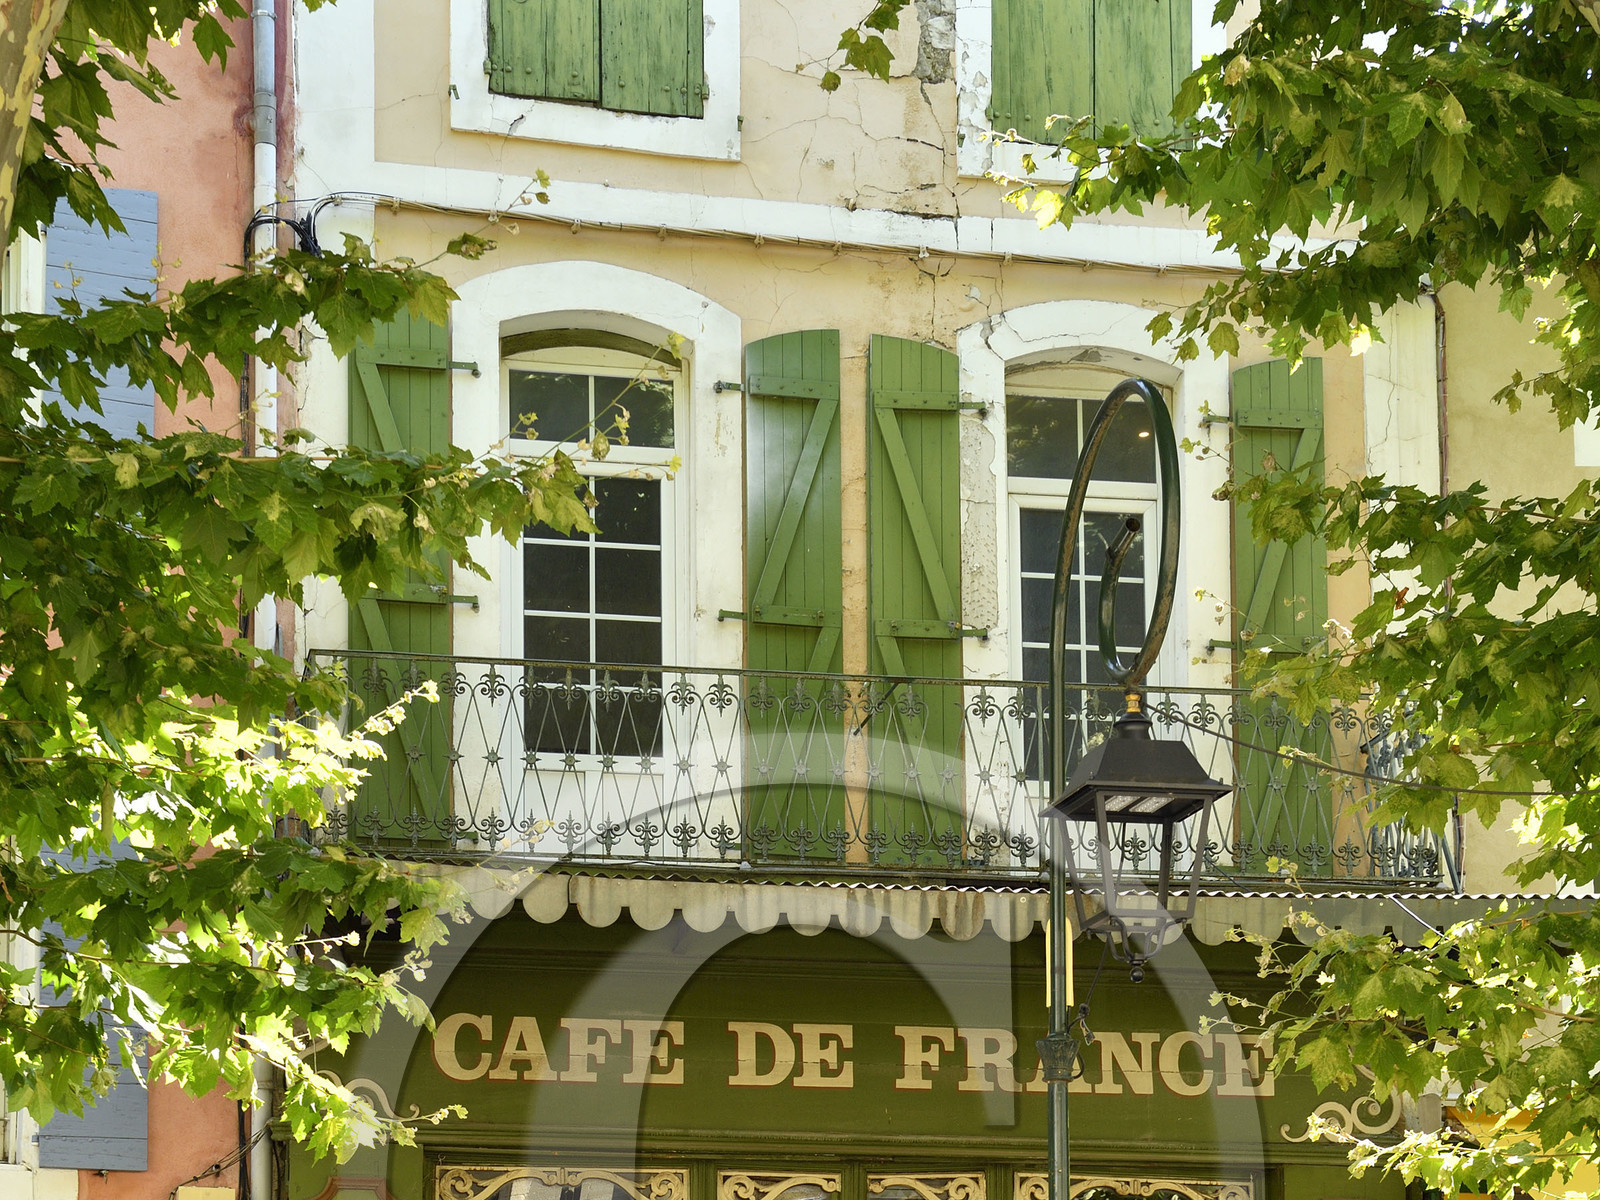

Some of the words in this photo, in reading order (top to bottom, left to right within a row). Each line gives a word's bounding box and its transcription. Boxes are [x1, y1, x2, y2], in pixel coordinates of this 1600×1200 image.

[432, 1012, 684, 1086] CAFE
[727, 1021, 854, 1089] DE
[894, 1025, 1276, 1098] FRANCE
